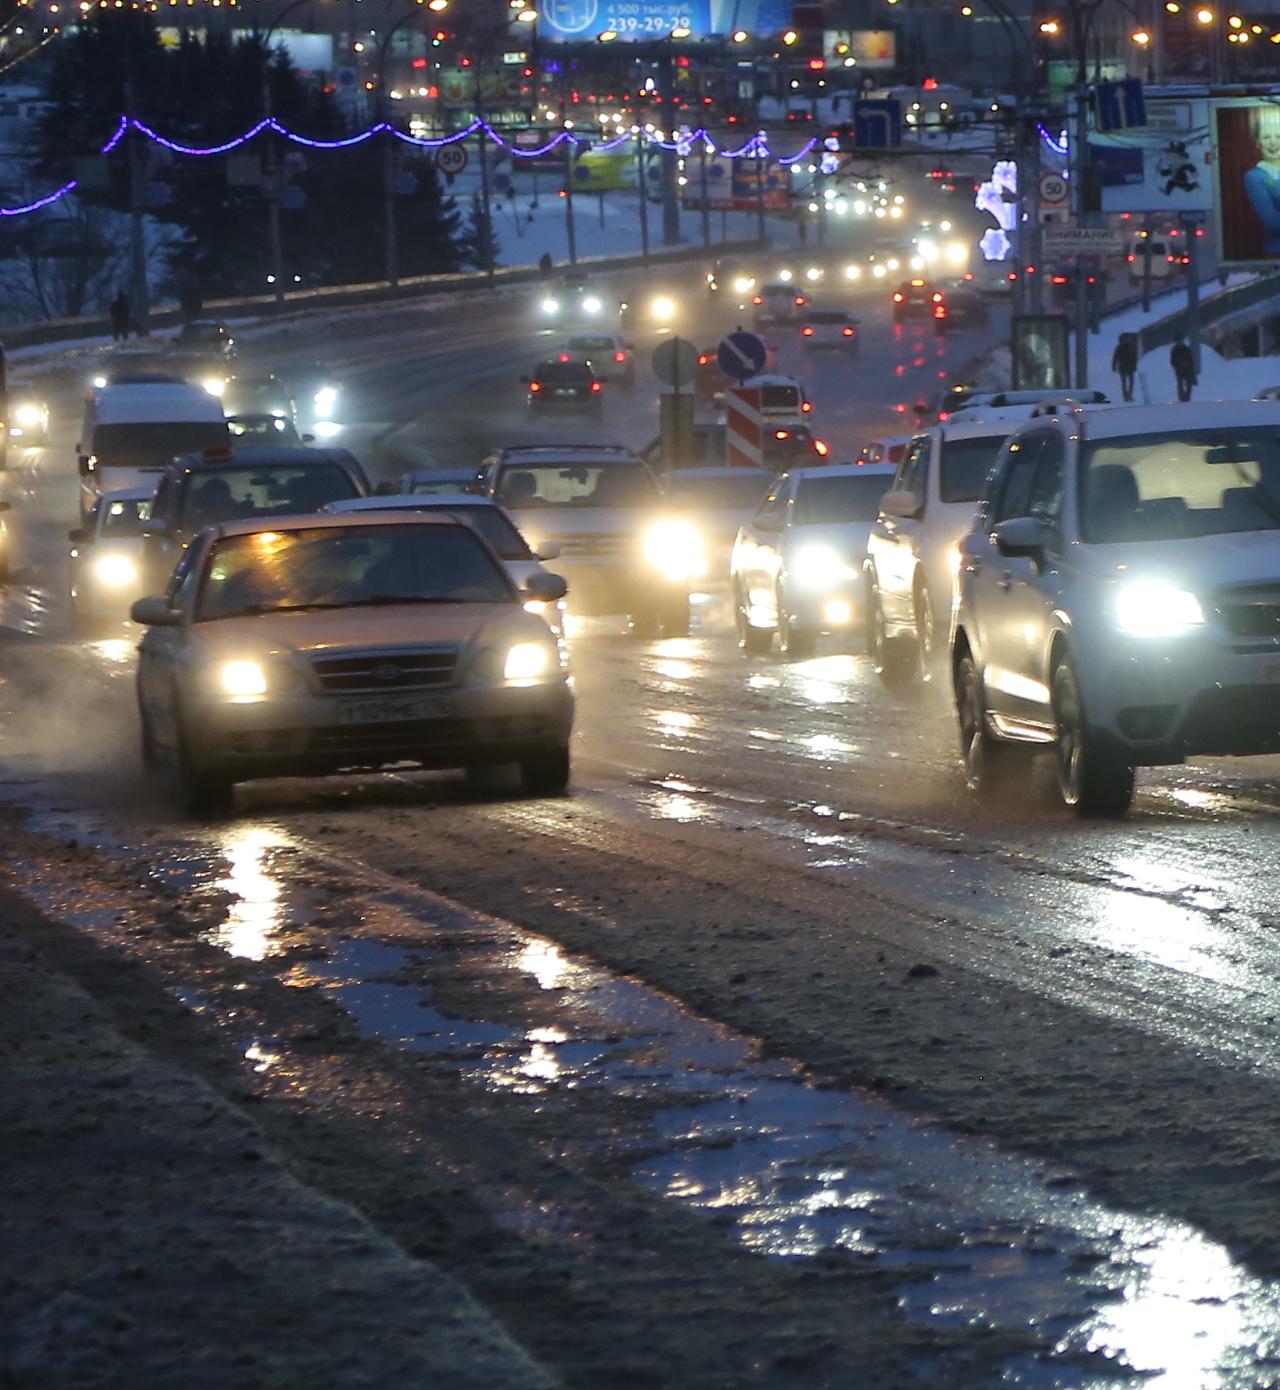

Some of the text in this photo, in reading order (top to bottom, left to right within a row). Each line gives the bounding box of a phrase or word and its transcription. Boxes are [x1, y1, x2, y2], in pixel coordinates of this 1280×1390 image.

[607, 17, 691, 32] 239-29-29
[443, 151, 461, 164] 50
[1045, 182, 1062, 195] 50
